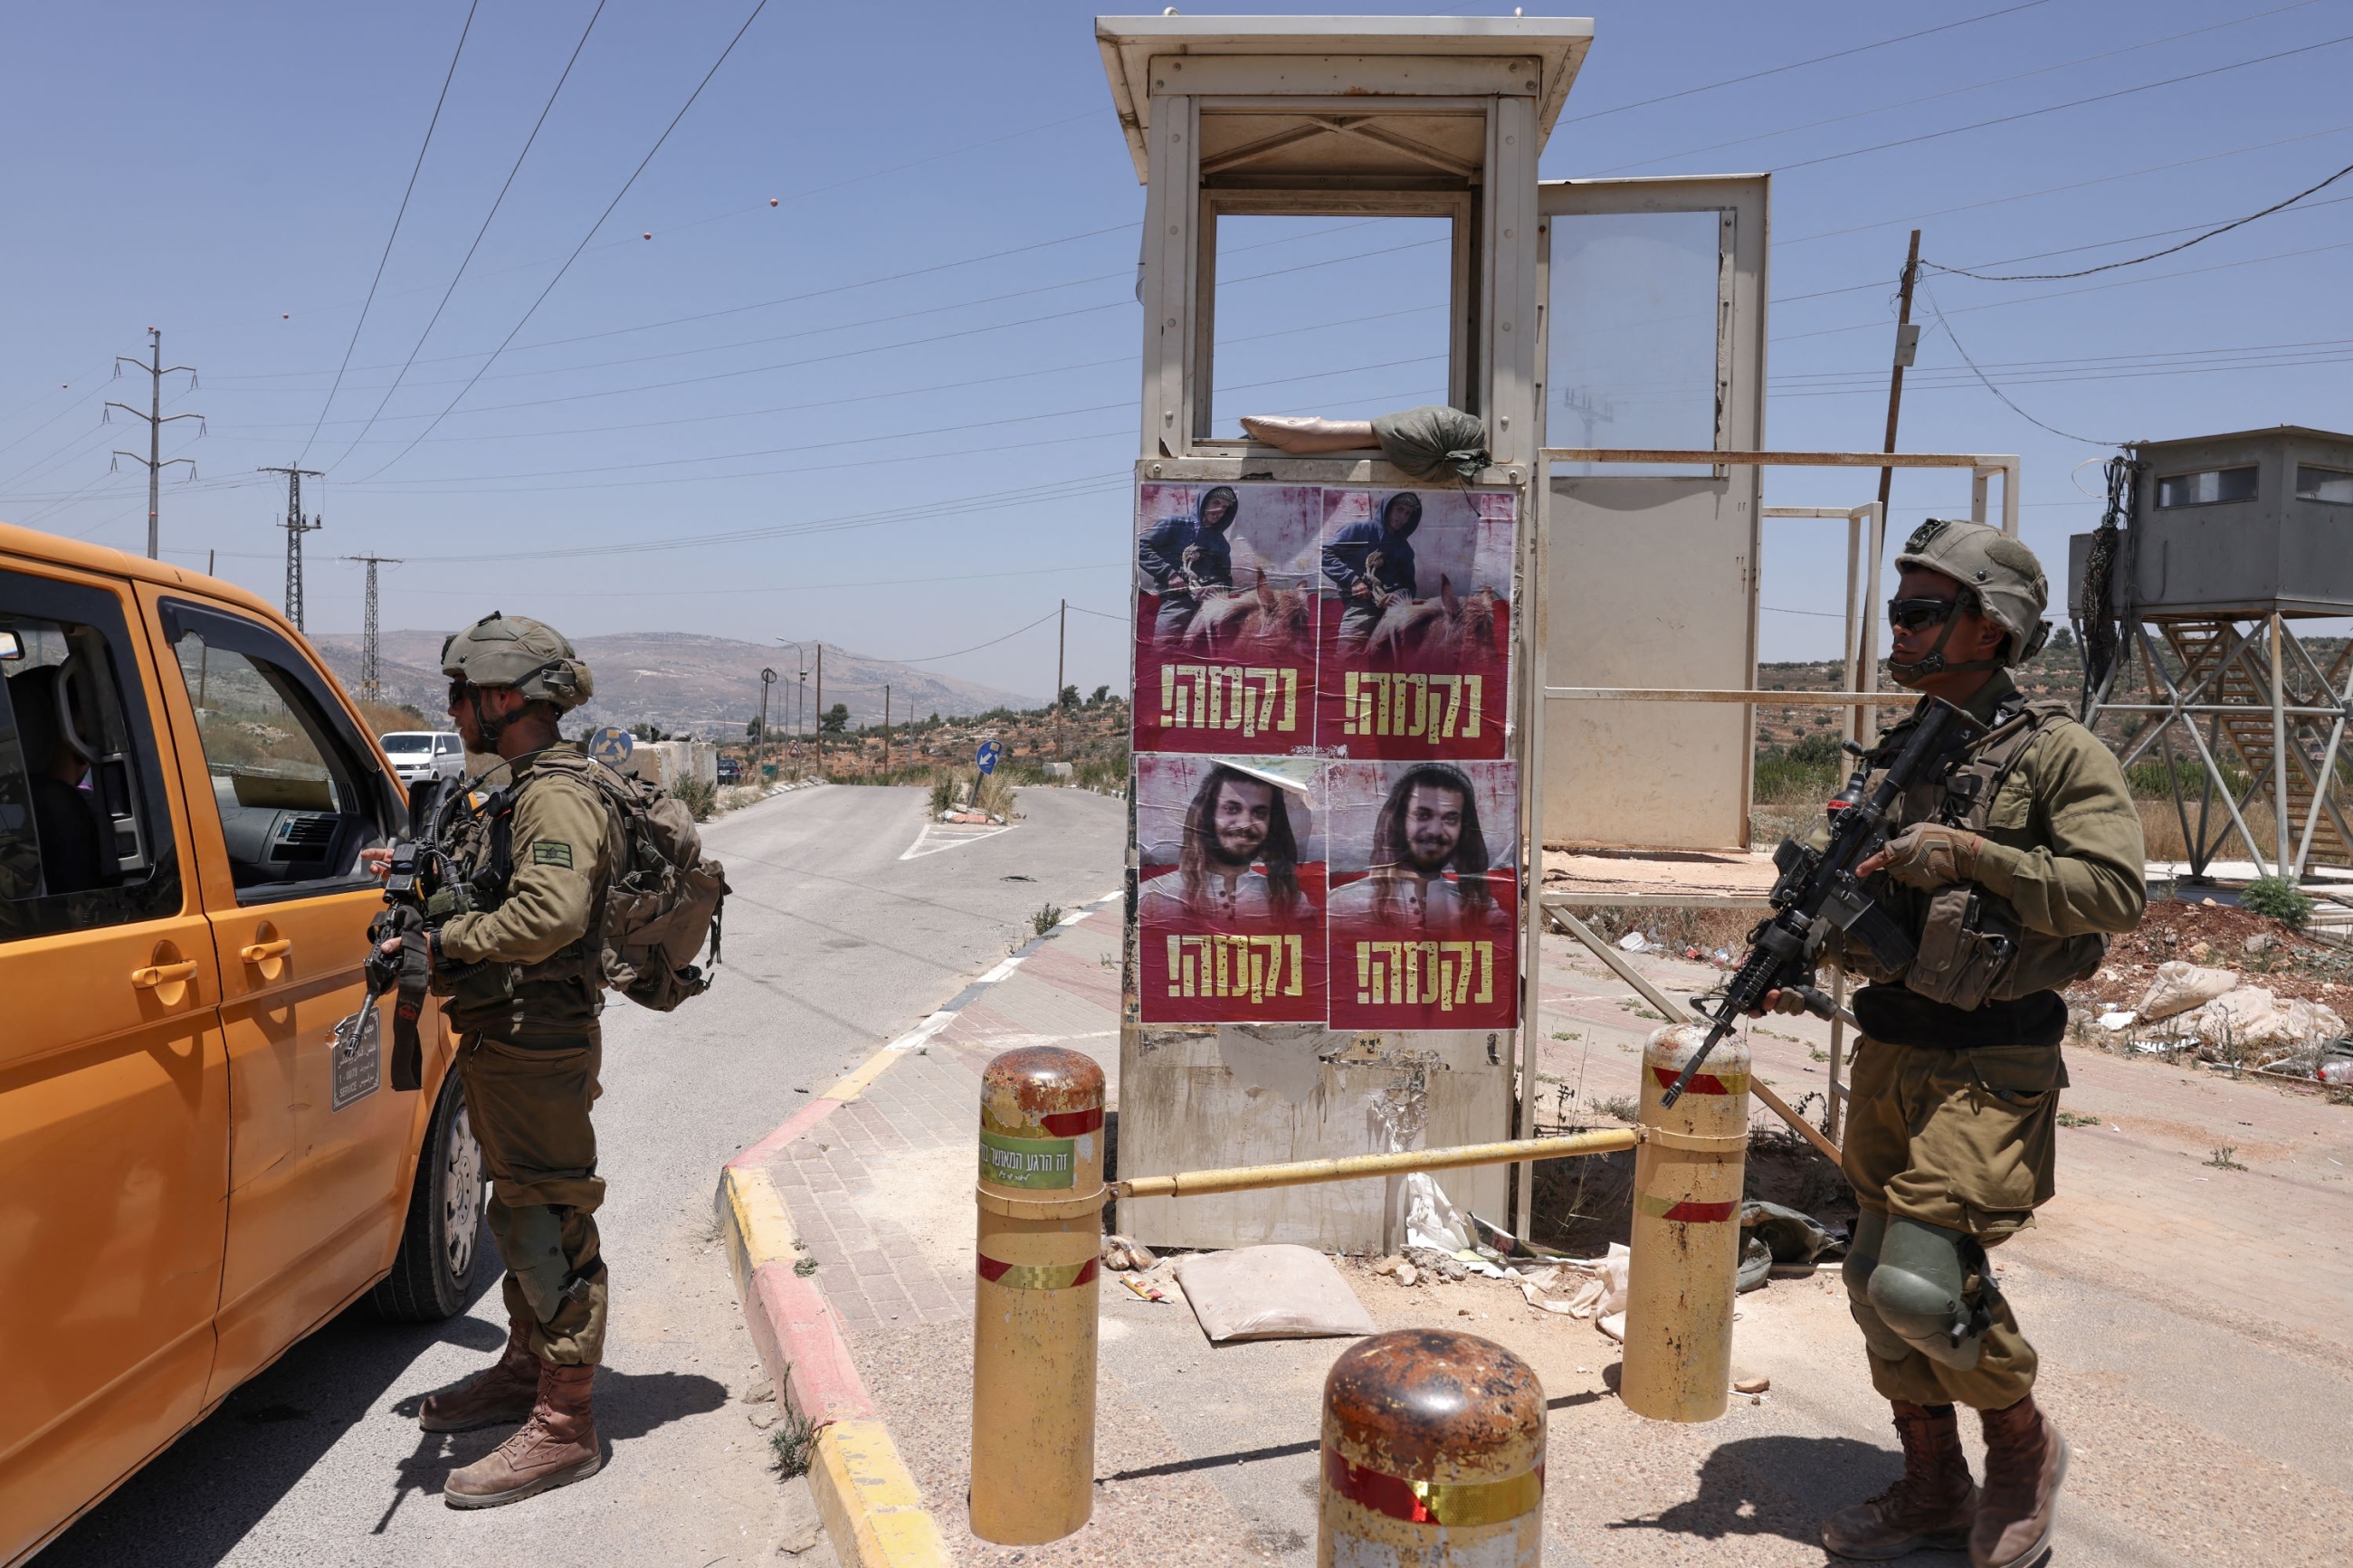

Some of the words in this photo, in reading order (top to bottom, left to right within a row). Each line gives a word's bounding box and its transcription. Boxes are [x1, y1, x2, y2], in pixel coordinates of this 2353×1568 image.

[1159, 663, 1298, 738] נקמה!
[1344, 670, 1482, 745] נקמה!
[1167, 934, 1303, 1004] נקמה!
[1356, 940, 1493, 1012] נקמה!
[339, 1079, 357, 1098] SERVICE
[990, 1147, 1023, 1171] המאושר
[1026, 1154, 1053, 1172] הרגע
[1056, 1153, 1068, 1172] זה
